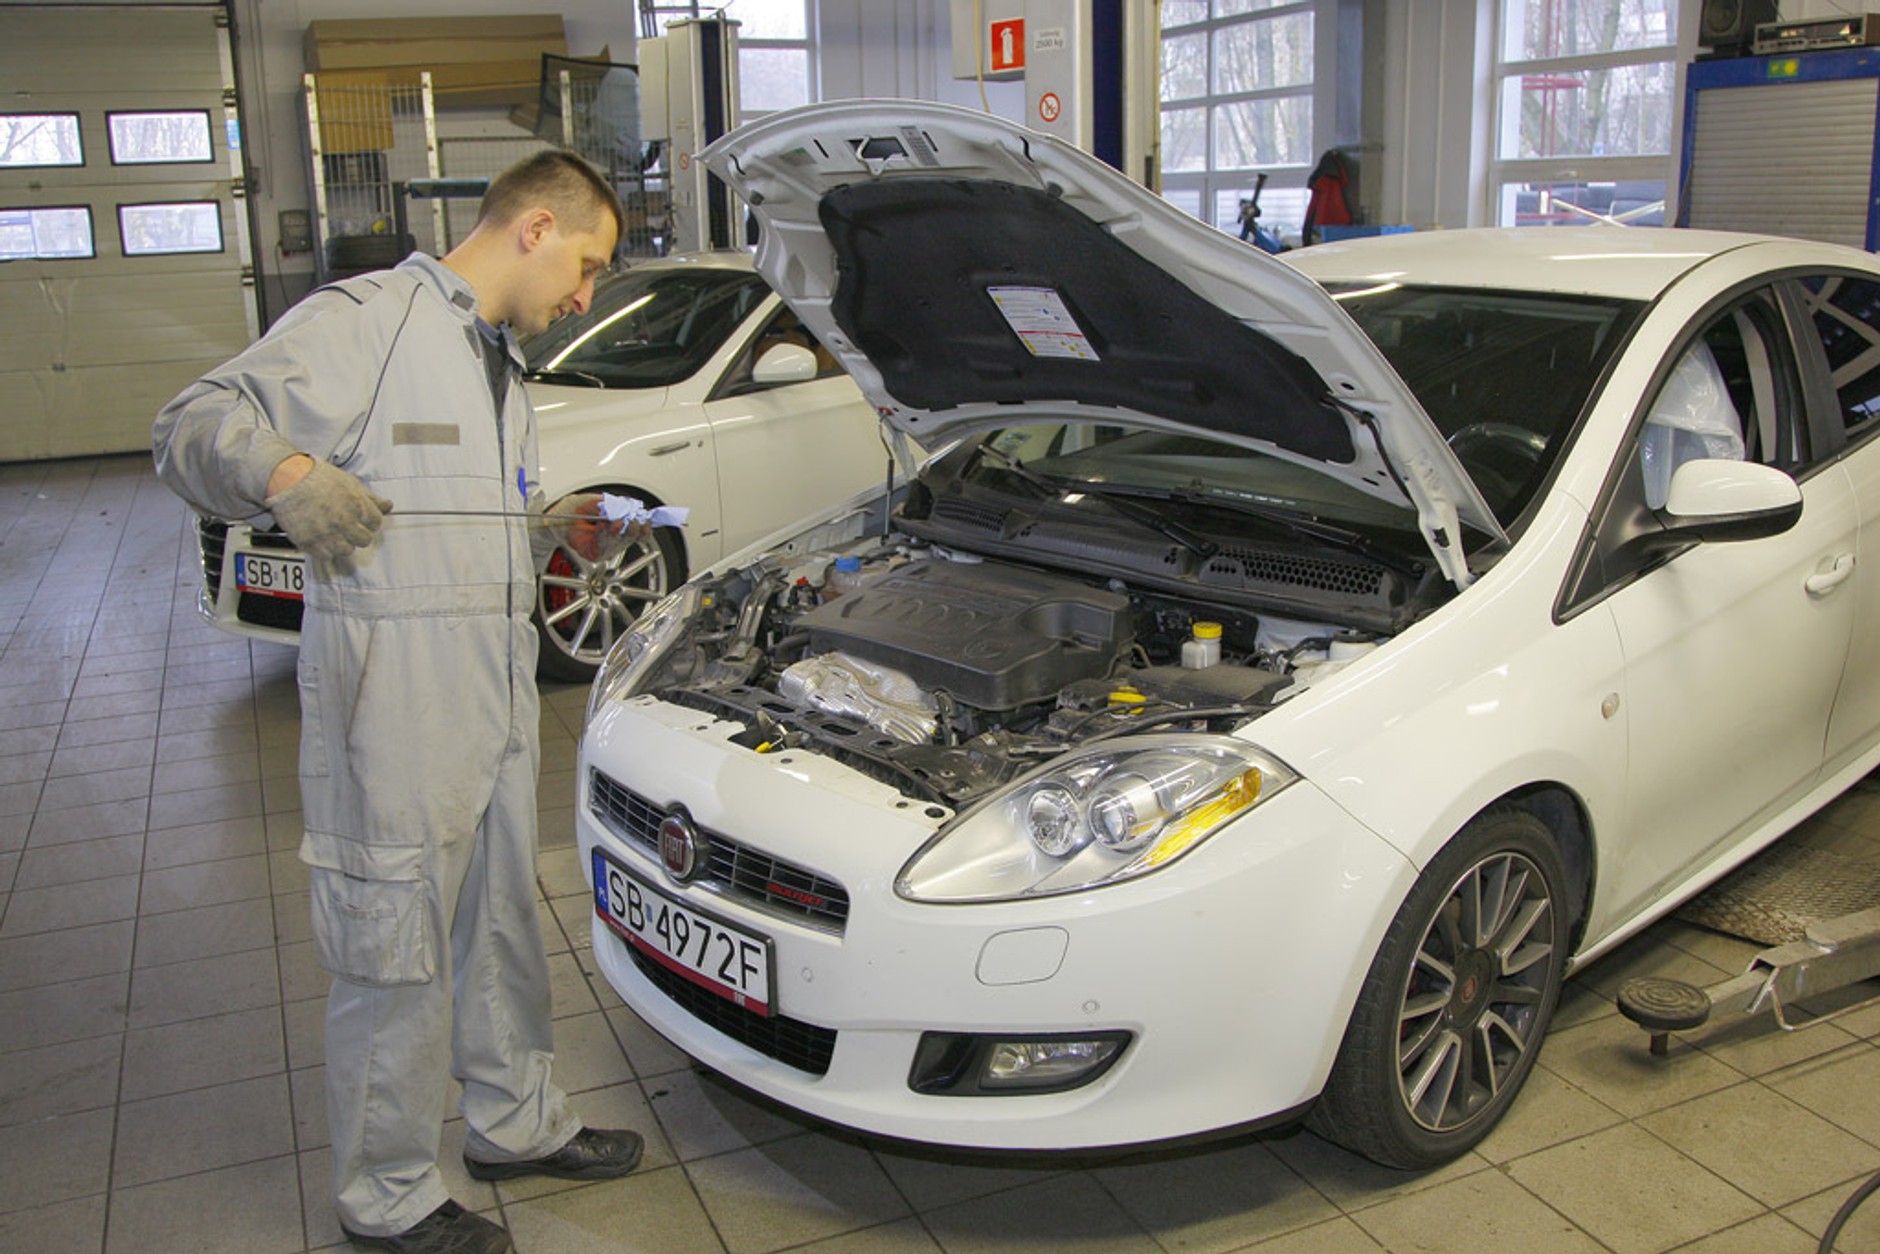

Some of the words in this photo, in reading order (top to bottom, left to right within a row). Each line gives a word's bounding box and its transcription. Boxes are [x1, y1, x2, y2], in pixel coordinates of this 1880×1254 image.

[247, 559, 273, 587] SB
[281, 564, 304, 591] 18
[609, 869, 645, 932] SB
[656, 903, 761, 990] 4972F
